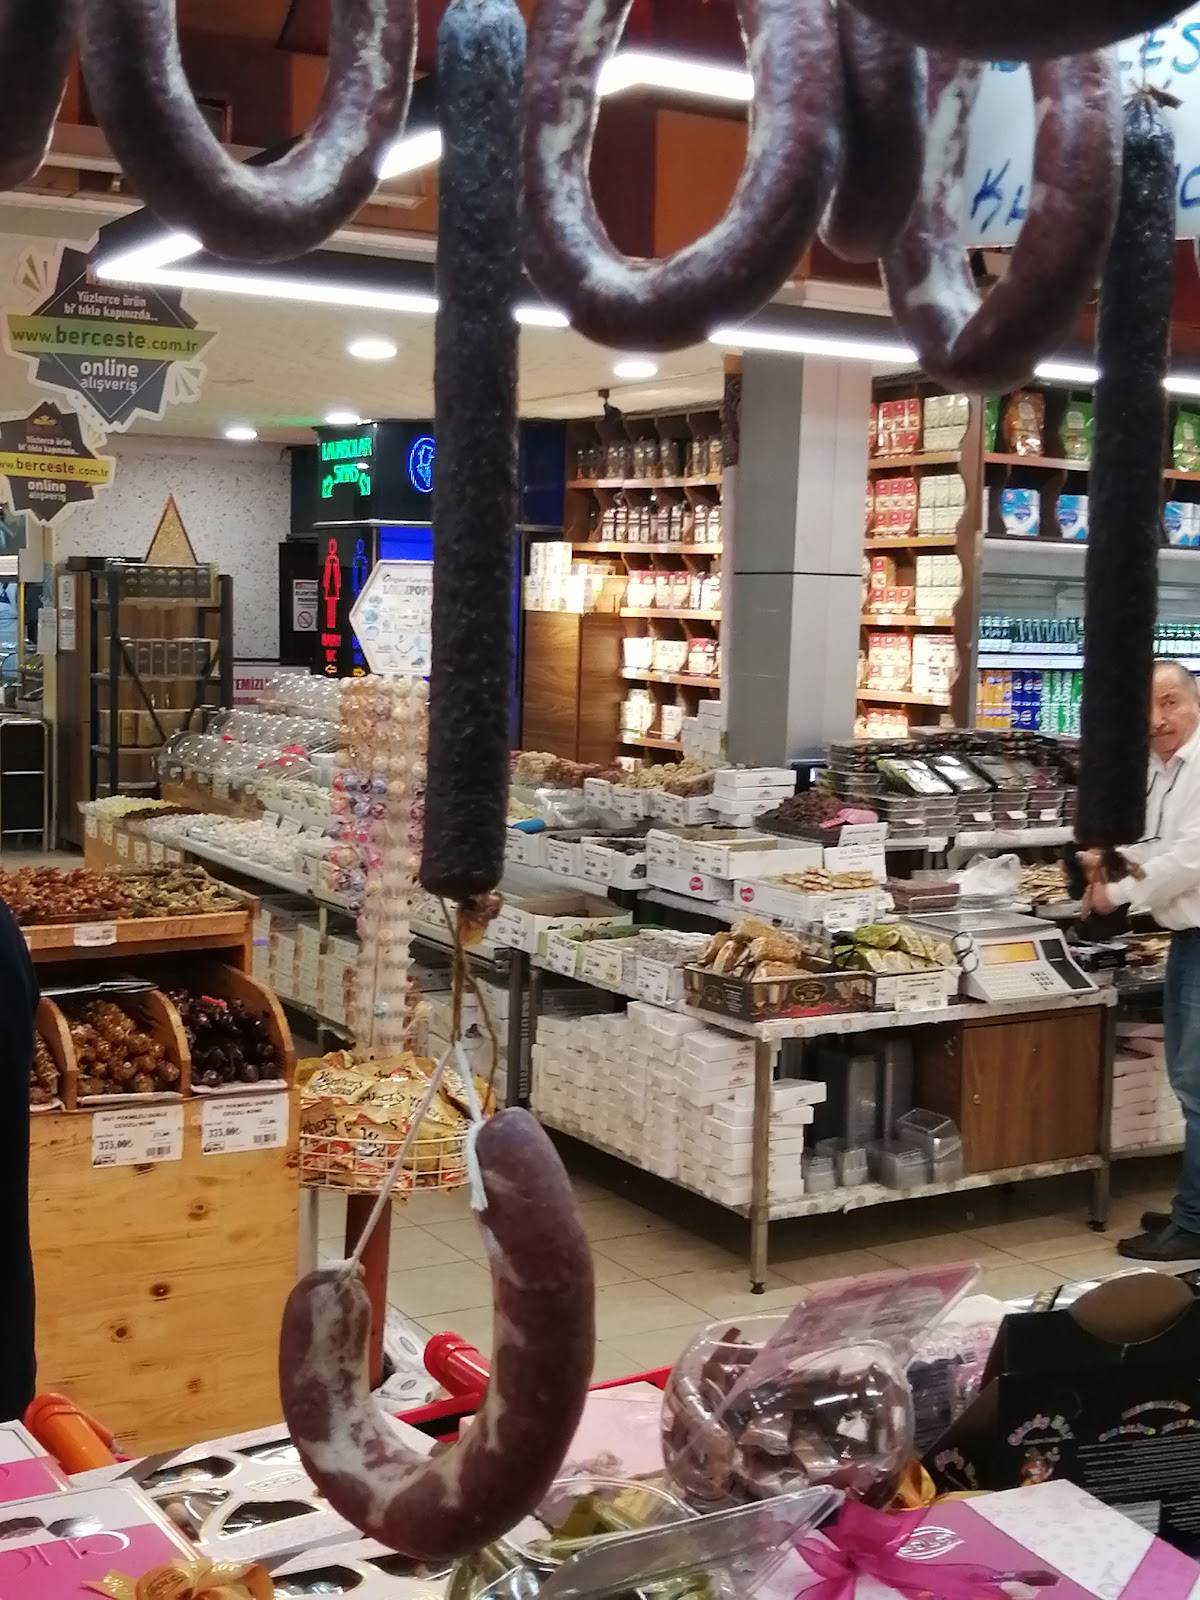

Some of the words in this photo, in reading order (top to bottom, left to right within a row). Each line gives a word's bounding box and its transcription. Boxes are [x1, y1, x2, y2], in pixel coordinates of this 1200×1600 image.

[77, 291, 120, 306] Yüzlerce
[122, 293, 147, 307] ürün
[11, 325, 199, 352] www.berceste.com.tr
[80, 358, 140, 378] online
[80, 377, 138, 395] alışveriş
[27, 480, 67, 492] online
